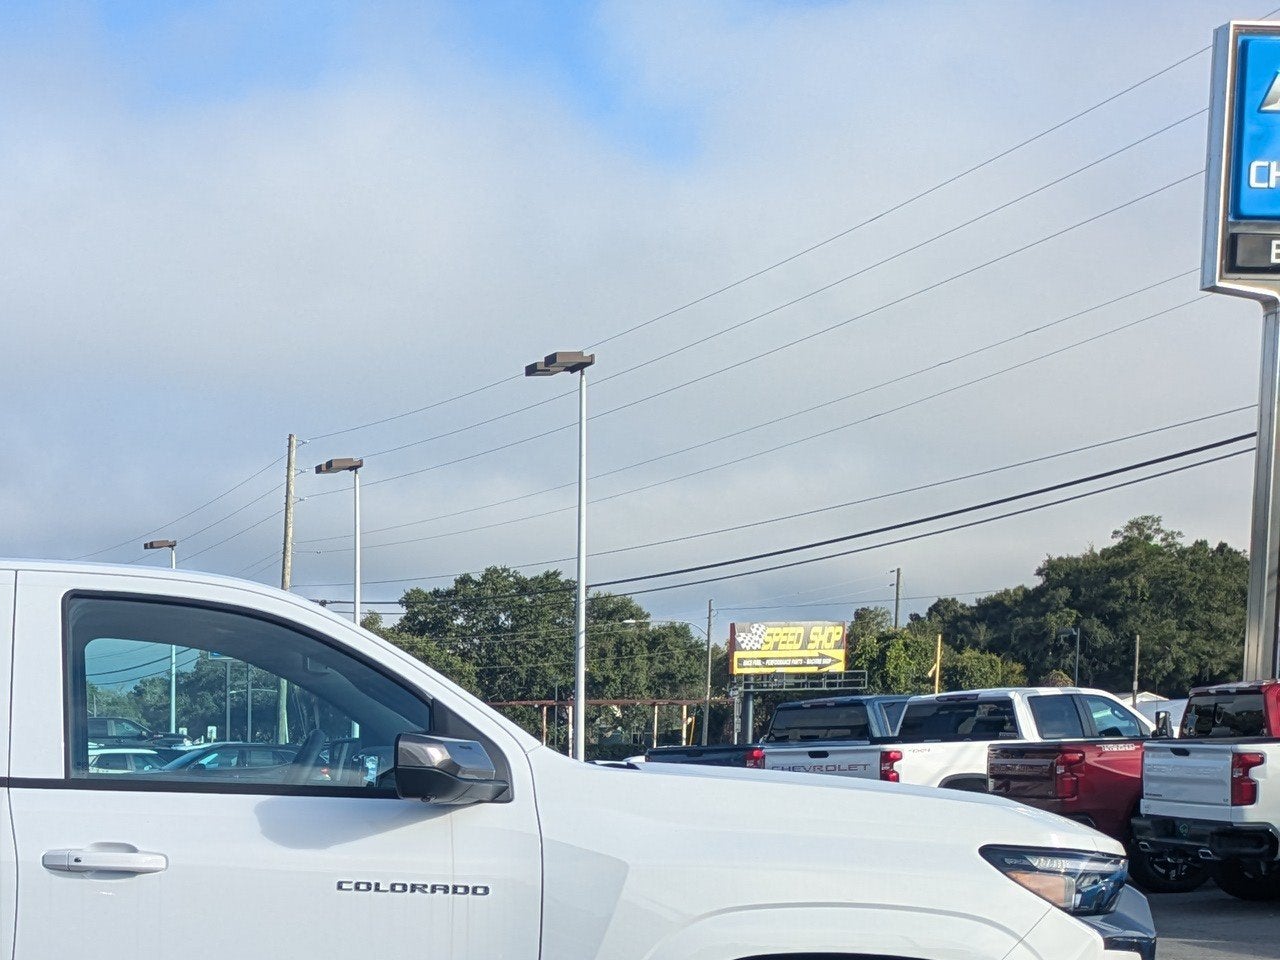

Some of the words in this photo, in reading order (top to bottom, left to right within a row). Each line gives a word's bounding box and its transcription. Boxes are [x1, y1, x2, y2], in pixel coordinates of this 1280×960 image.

[761, 625, 805, 651] SPEED
[807, 625, 844, 650] SHOP
[335, 880, 491, 896] COLORADO
